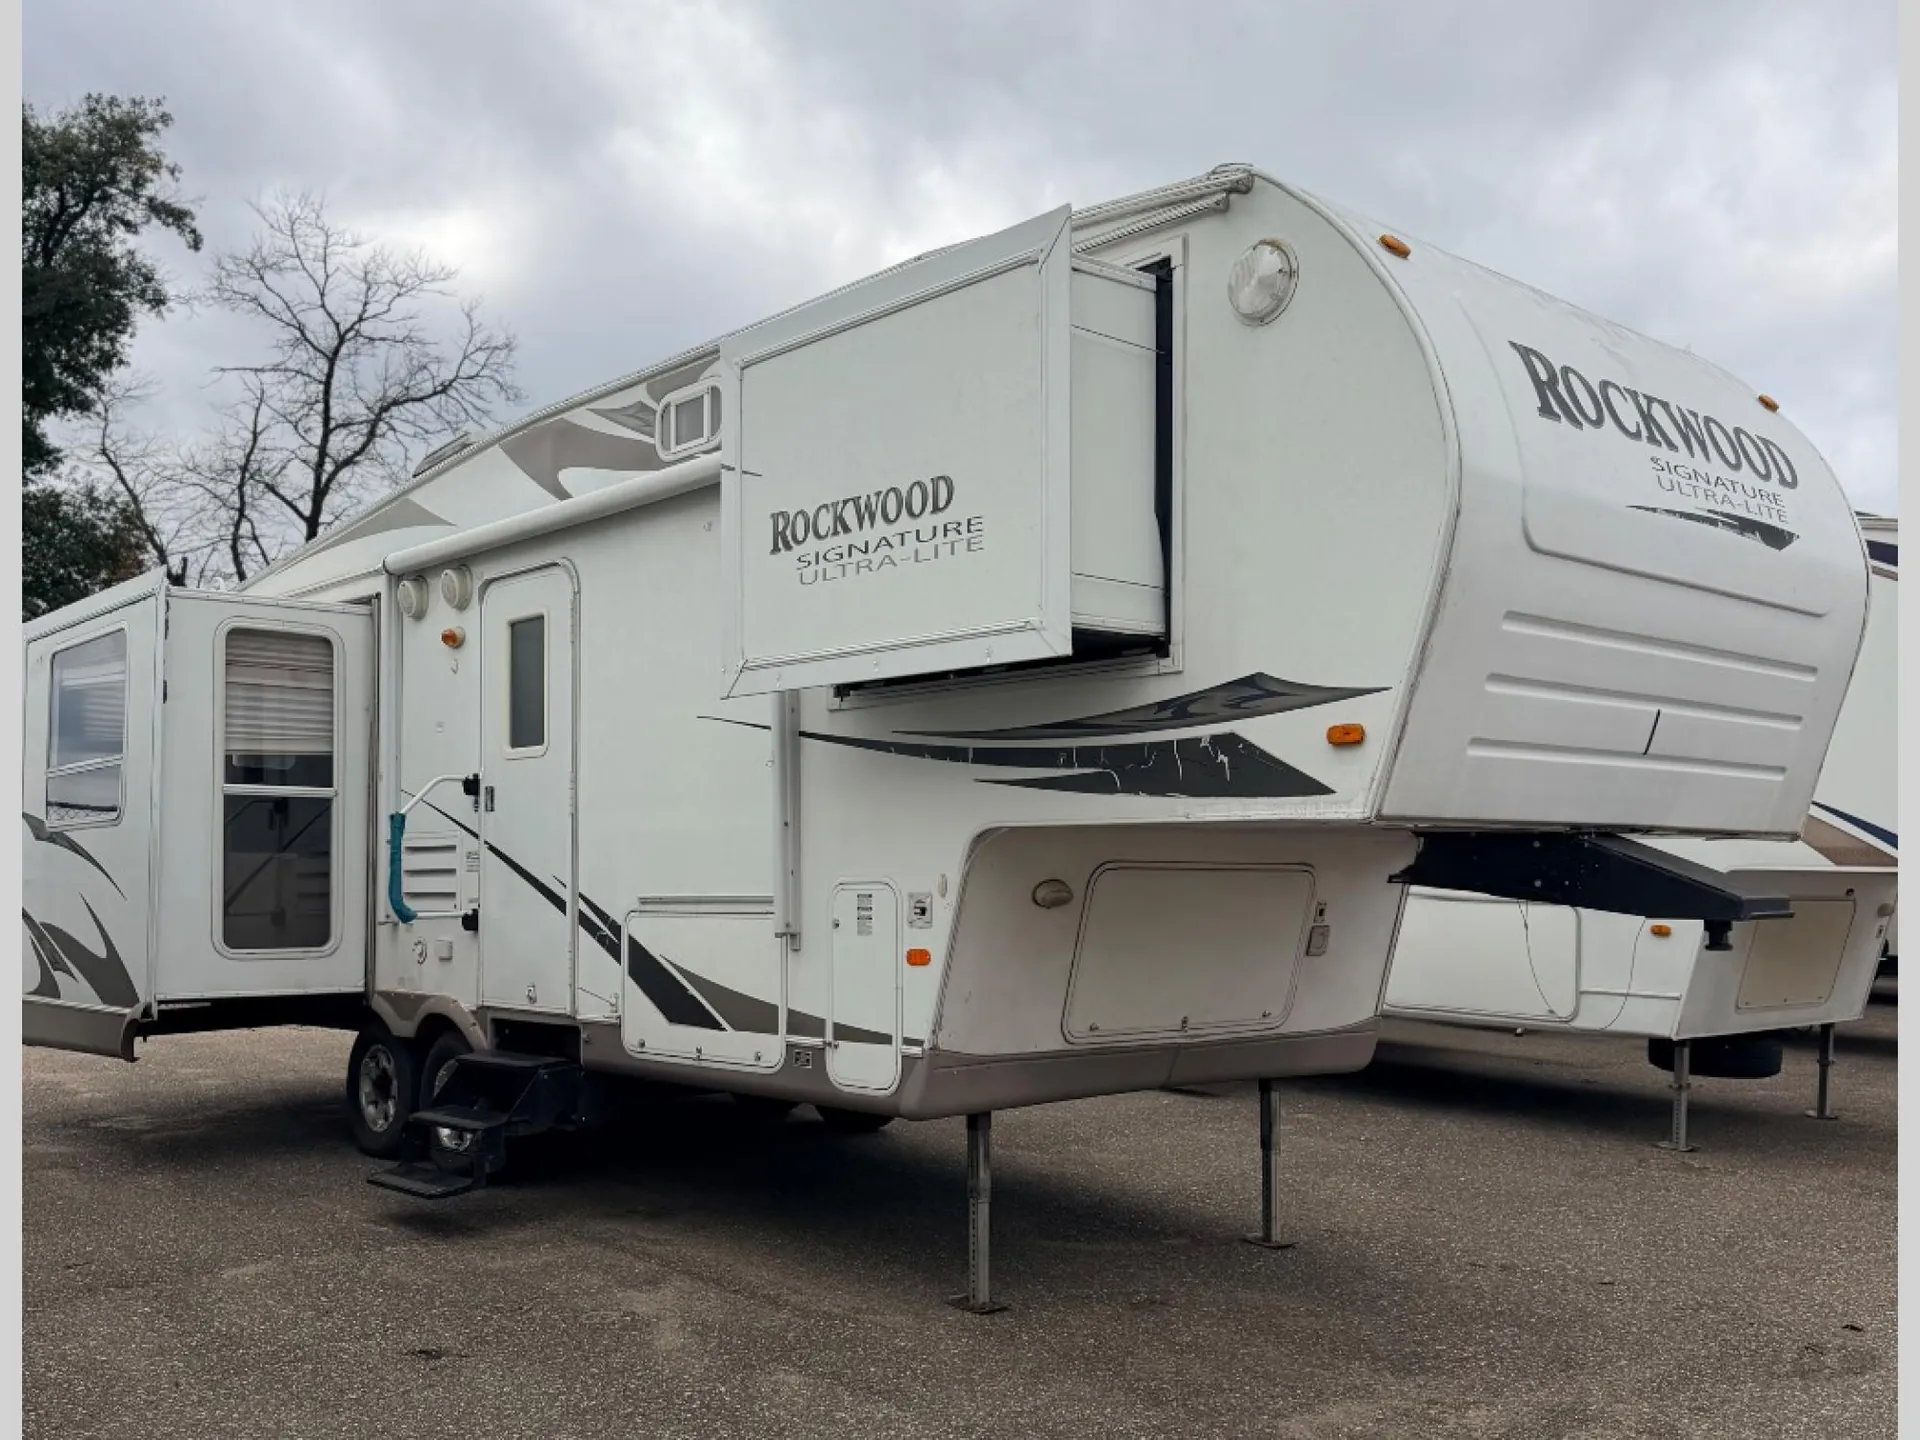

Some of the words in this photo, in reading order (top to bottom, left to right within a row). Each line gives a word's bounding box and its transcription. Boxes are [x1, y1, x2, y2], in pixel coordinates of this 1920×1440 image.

[1508, 340, 1798, 489] ROCKWOOD
[1651, 455, 1784, 505] SIGNATURE
[1656, 475, 1789, 524] ULTRA-LITE
[770, 475, 955, 555] ROCKWOOD
[797, 516, 984, 570] SIGNATURE
[799, 535, 984, 585] ULTRA-LITE
